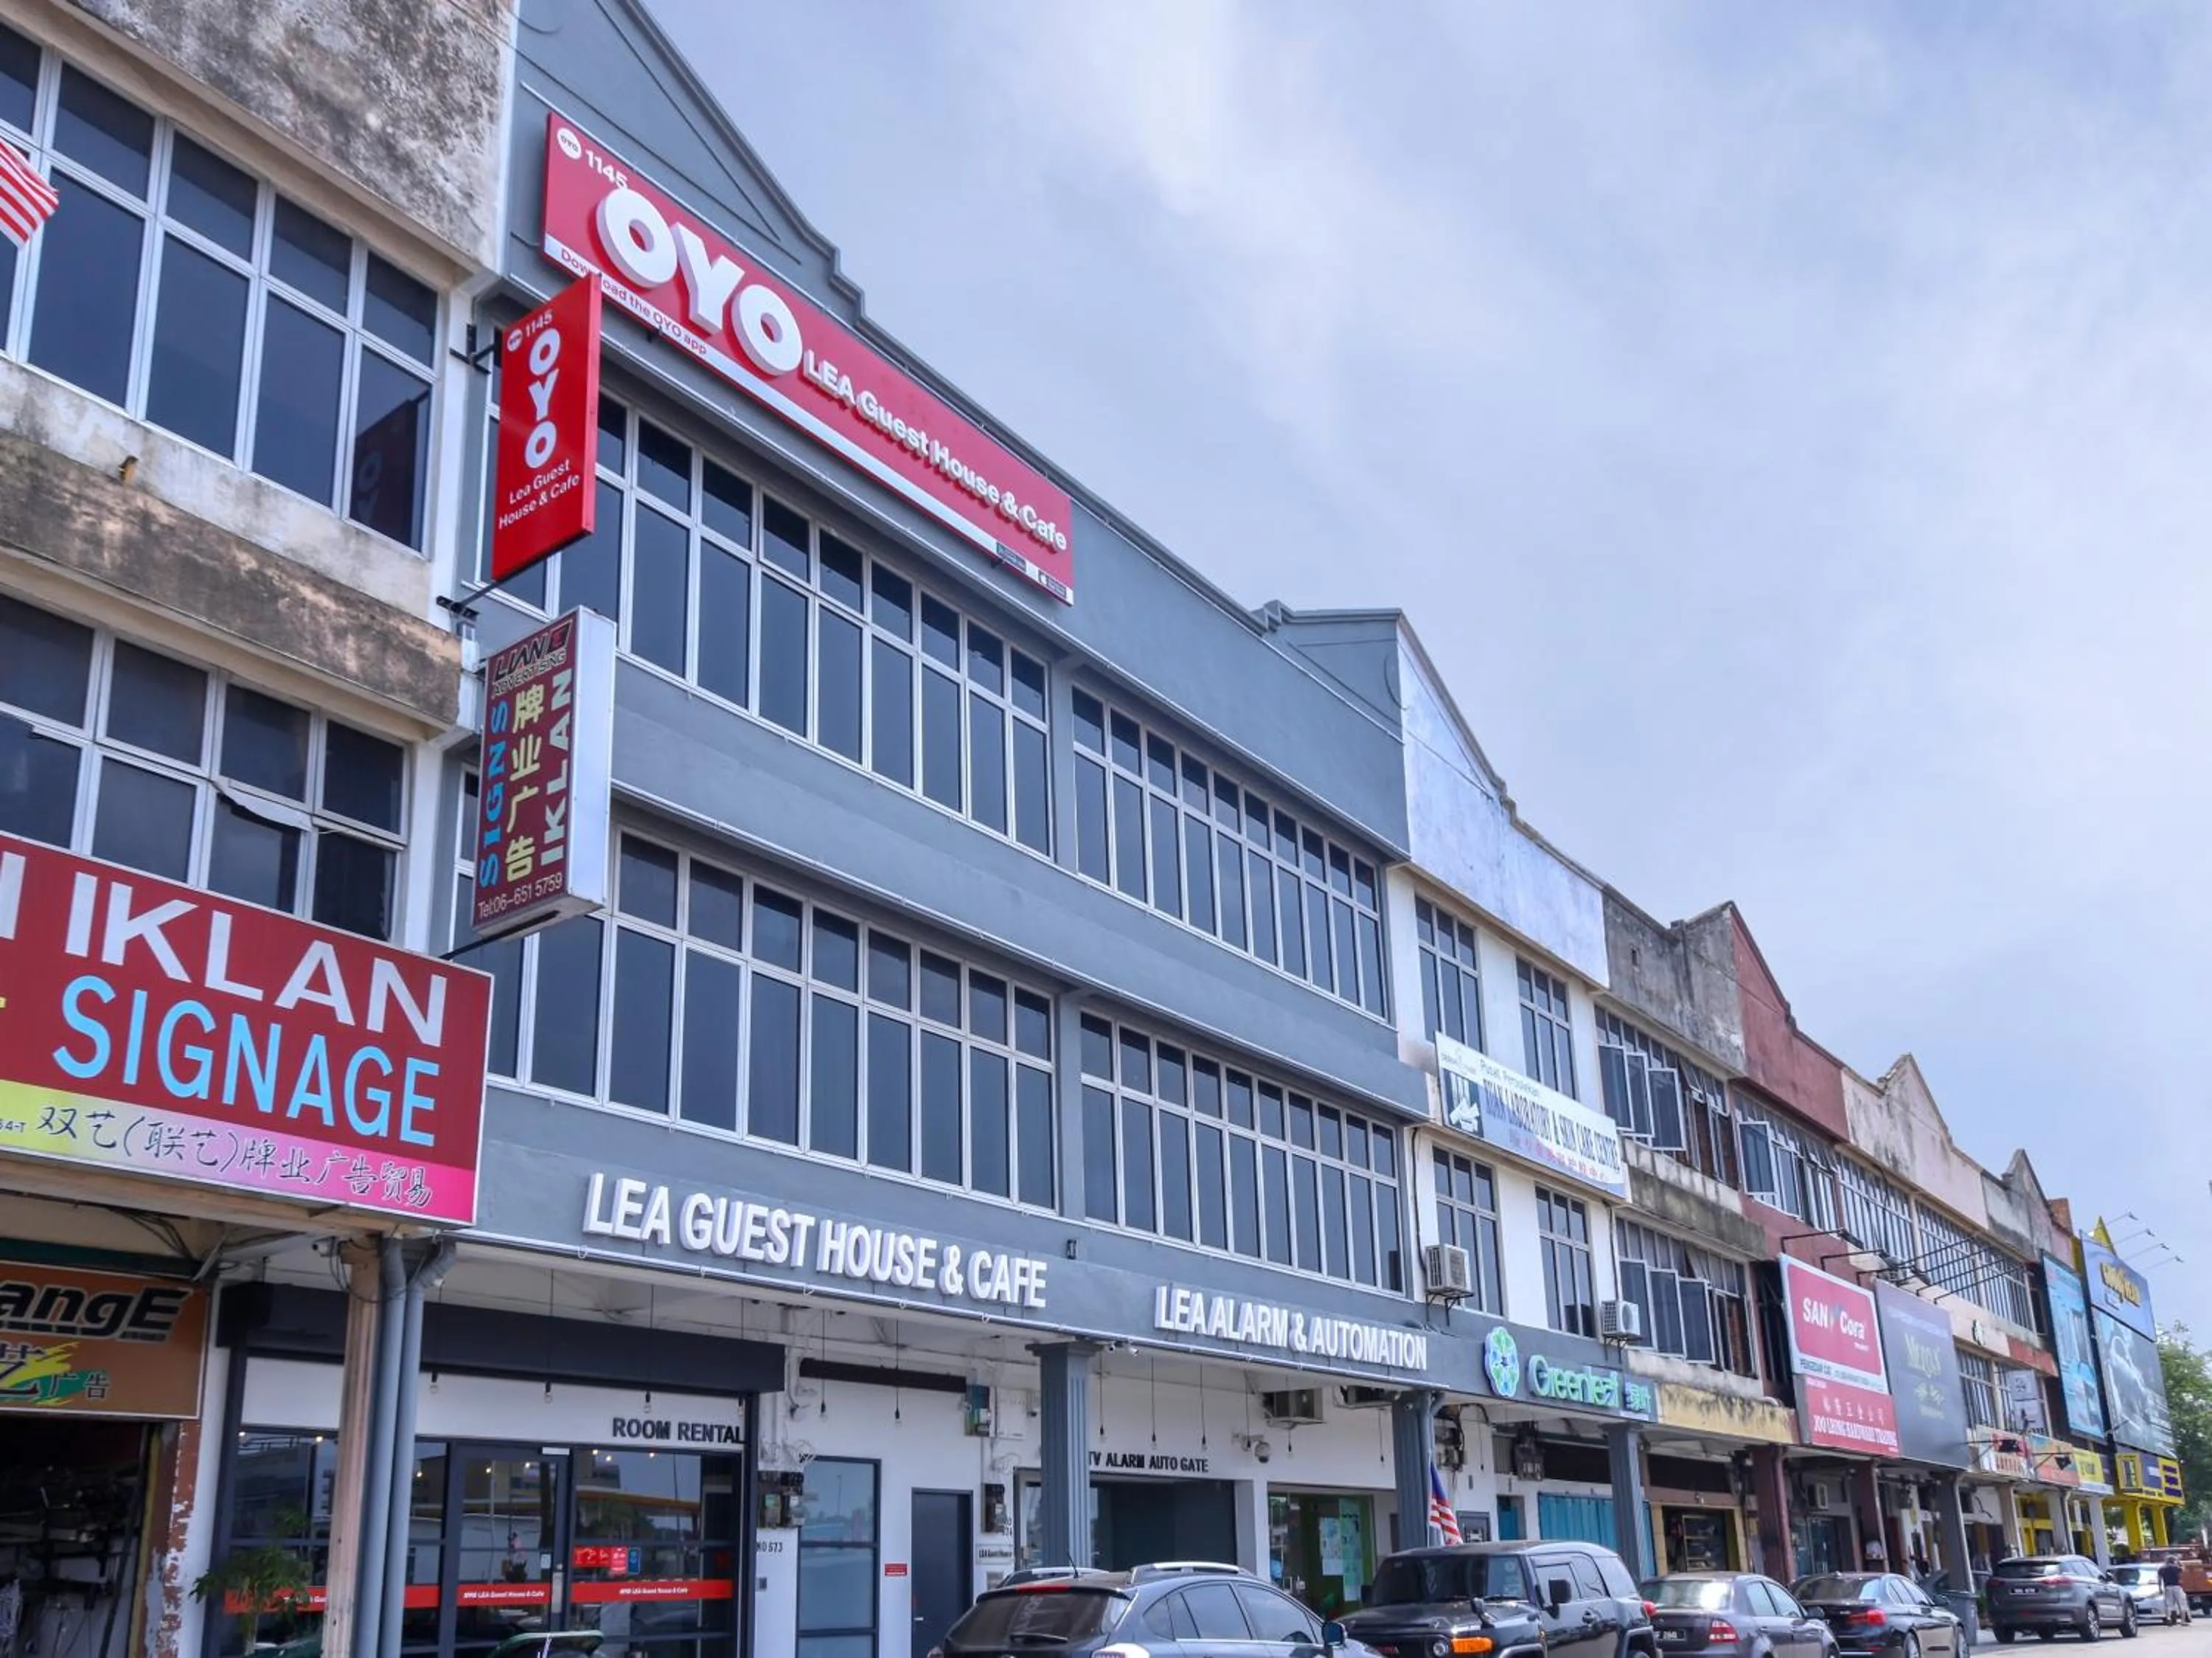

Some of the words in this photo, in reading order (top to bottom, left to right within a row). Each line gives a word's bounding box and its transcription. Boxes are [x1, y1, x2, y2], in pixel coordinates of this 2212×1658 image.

[585, 149, 627, 190] 1145
[526, 309, 553, 338] 1145
[561, 249, 627, 301] Dowoad
[630, 296, 651, 318] the
[653, 311, 682, 338] OYO
[684, 333, 708, 355] app
[596, 187, 803, 376] OYO
[524, 328, 561, 469] OYO
[804, 350, 855, 407] LEA
[856, 390, 931, 457] Guest
[929, 441, 1000, 504] House
[998, 491, 1020, 520] &
[1019, 505, 1068, 551] Cafe
[498, 499, 536, 530] House
[539, 490, 549, 506] &
[550, 474, 580, 503] Cafe
[509, 485, 531, 505] Lea
[532, 459, 571, 490] Guest
[479, 700, 508, 889] SIGNS
[504, 683, 545, 884] 牌业广告
[540, 667, 572, 867] IKLAN
[534, 873, 563, 901] 5759
[64, 870, 448, 1047] IKLAN
[52, 974, 440, 1147] SIGNAGE
[582, 1173, 670, 1245] LEA
[679, 1193, 815, 1269] GUEST
[816, 1219, 938, 1289] HOUSE
[941, 1244, 964, 1295] &
[968, 1250, 1048, 1308] CAFE
[1155, 1286, 1207, 1334] LEA
[1207, 1296, 1288, 1348] ALARM
[1289, 1312, 1308, 1352] &
[1310, 1317, 1427, 1371] AUTOMATION
[1802, 1297, 1829, 1329] SAN
[613, 1417, 671, 1440] ROOM
[678, 1421, 745, 1443] RENTAL
[1106, 1452, 1146, 1469] ALARM
[1149, 1455, 1178, 1471] AUTO
[1180, 1457, 1208, 1473] GATE
